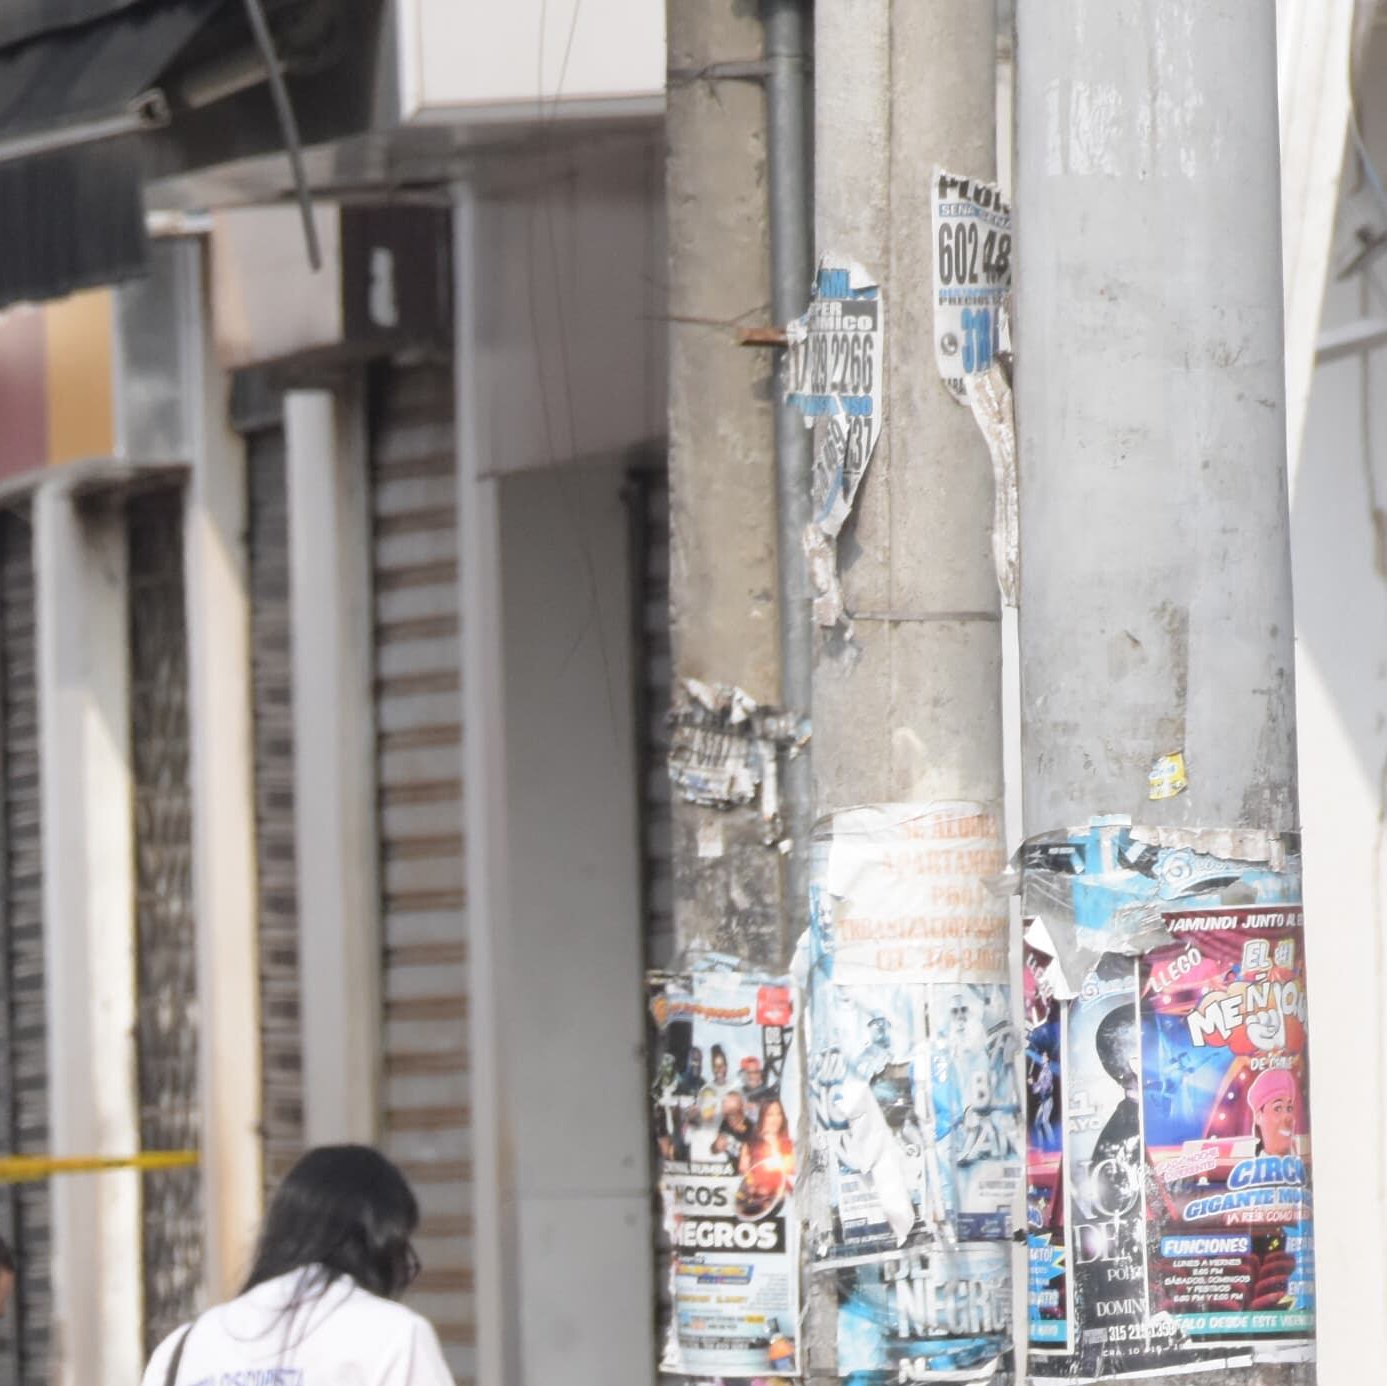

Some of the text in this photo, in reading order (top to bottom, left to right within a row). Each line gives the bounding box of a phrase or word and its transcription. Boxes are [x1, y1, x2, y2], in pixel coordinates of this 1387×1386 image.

[938, 222, 979, 285] 602
[1167, 916, 1237, 932] JAMUNDI
[1242, 914, 1284, 929] JUNTO
[1244, 939, 1272, 969] EL
[1184, 1188, 1275, 1221] GIGANTE
[1164, 1238, 1248, 1254] FUNCIONES
[1108, 1325, 1127, 1341] 315
